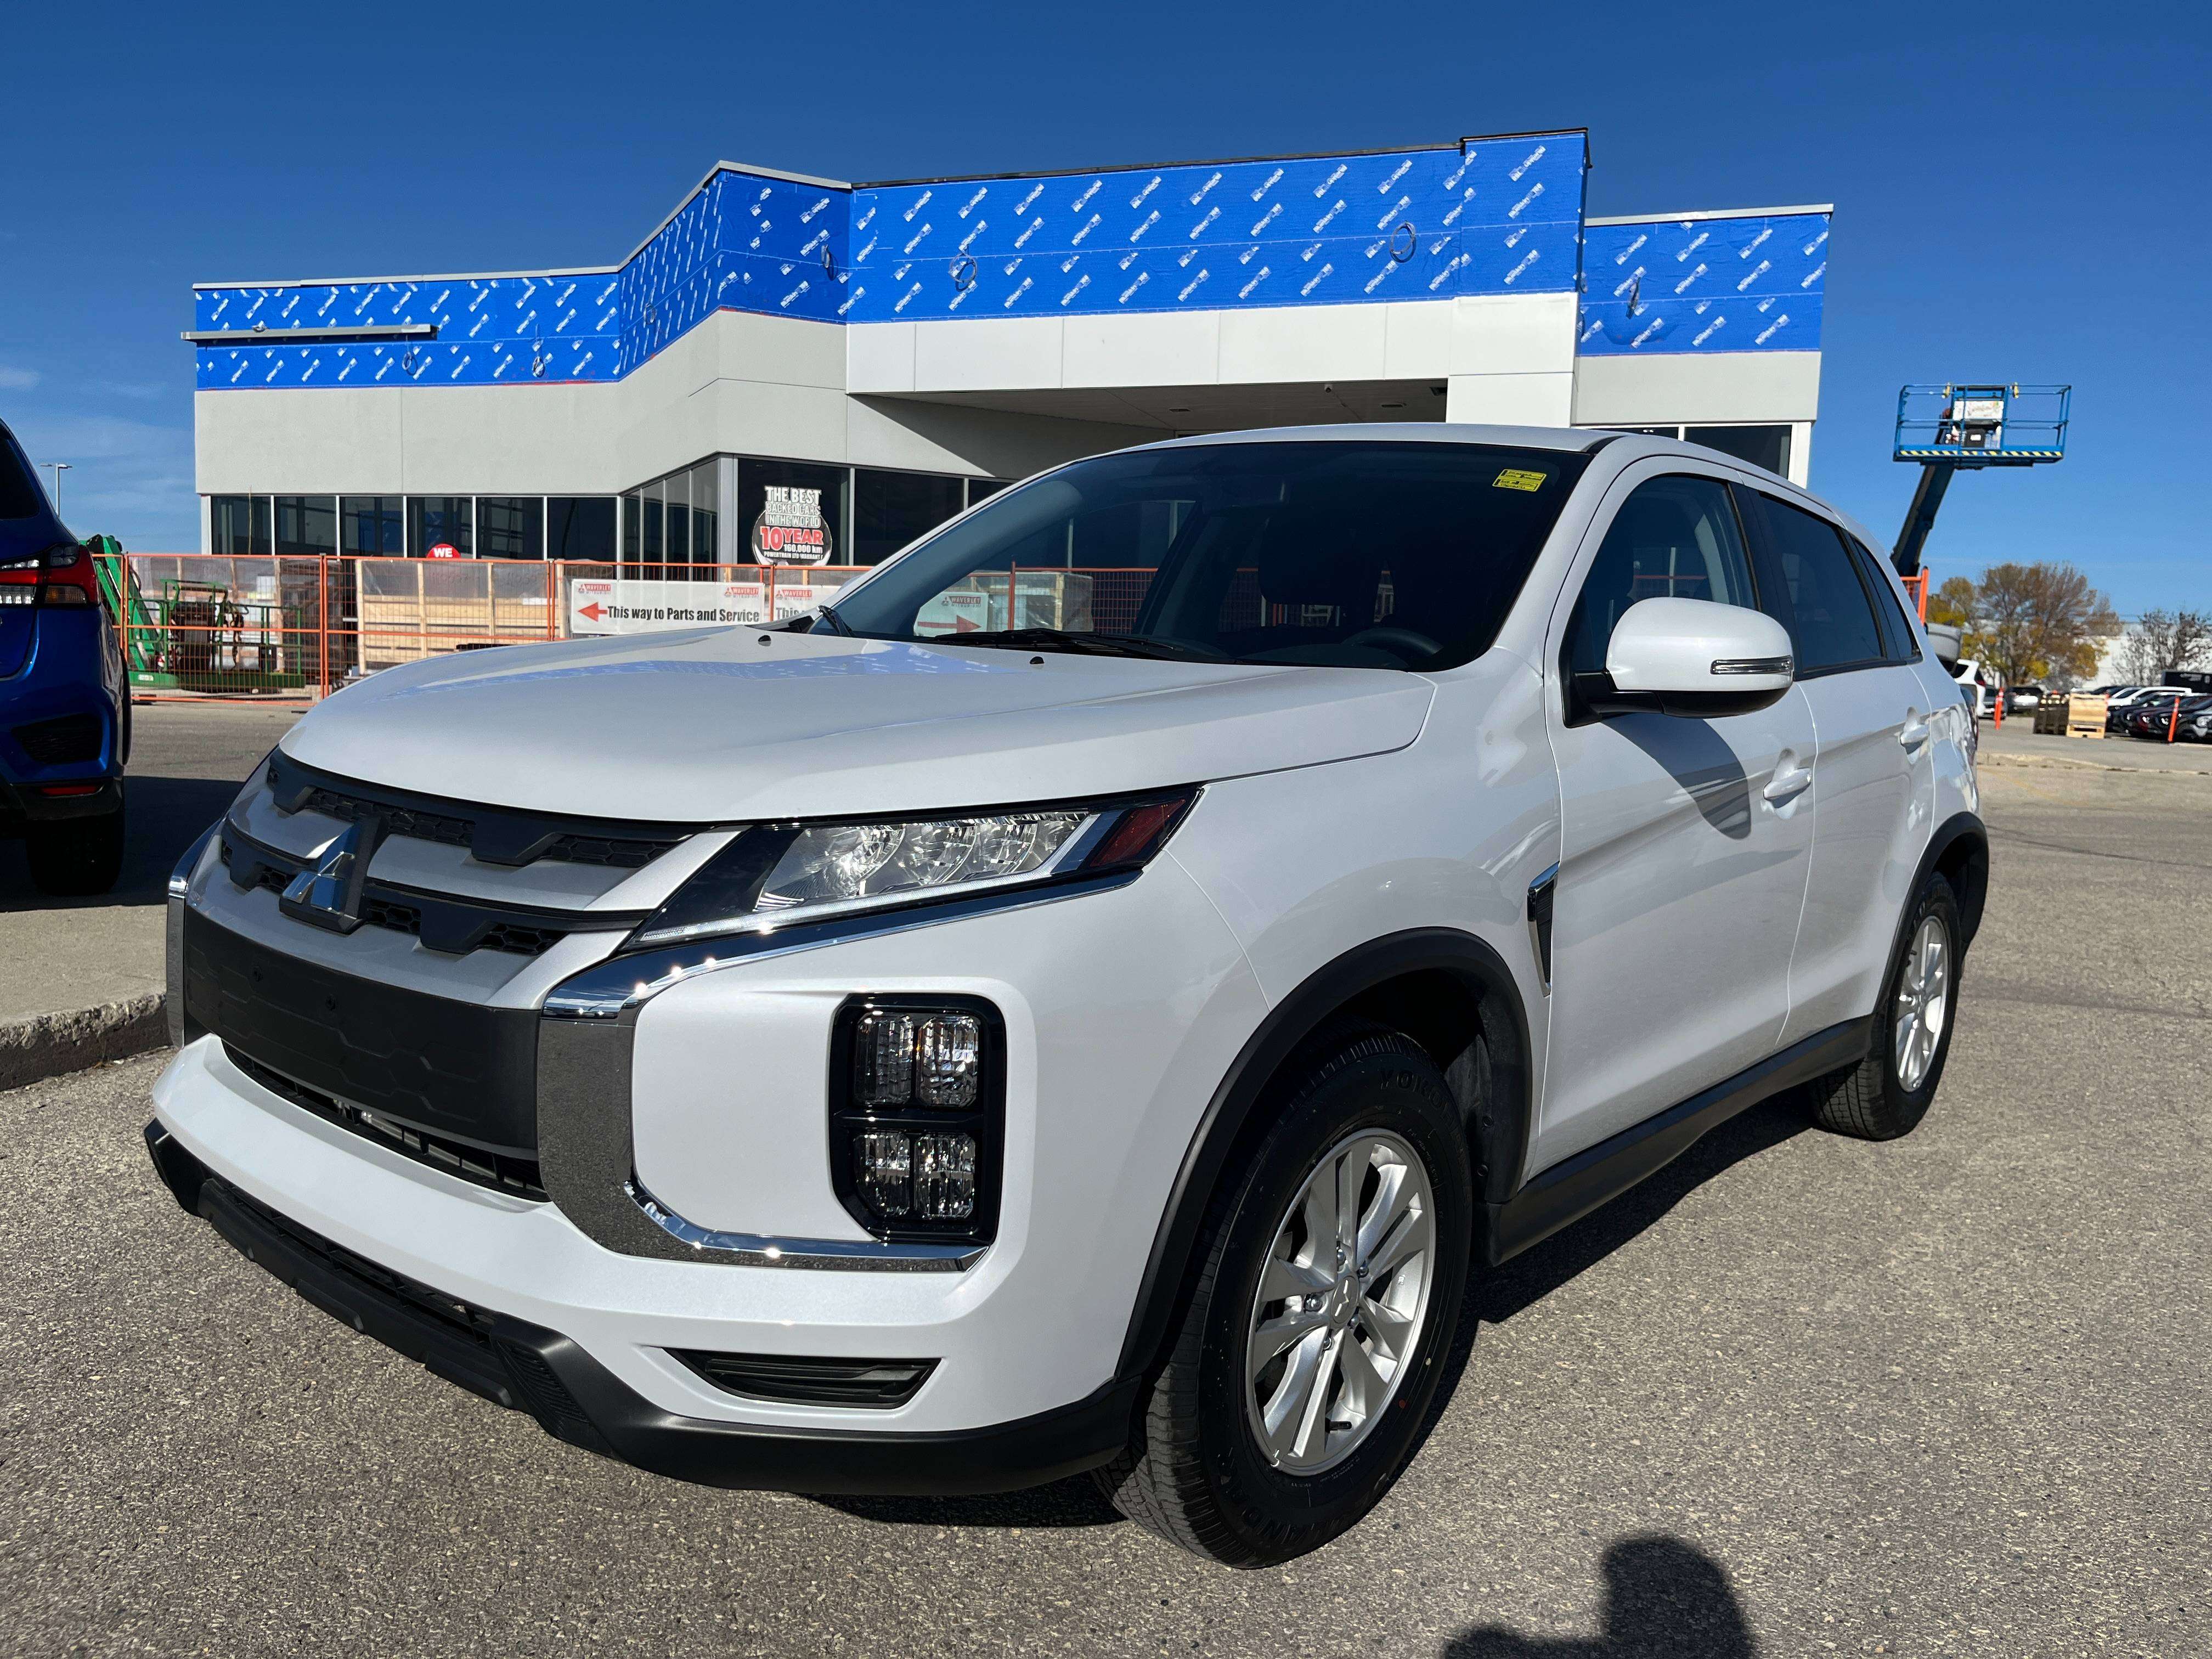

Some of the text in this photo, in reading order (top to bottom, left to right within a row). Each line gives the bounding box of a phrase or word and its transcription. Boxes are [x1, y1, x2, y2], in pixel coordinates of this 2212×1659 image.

[765, 486, 821, 505] THE BEST
[766, 503, 797, 514] BACKED
[766, 515, 821, 528] IN THE WORLD
[760, 527, 823, 551] 10 YEAR
[434, 548, 453, 557] WE
[783, 544, 823, 554] 160,000 km
[608, 606, 760, 622] This way to Parts and Service
